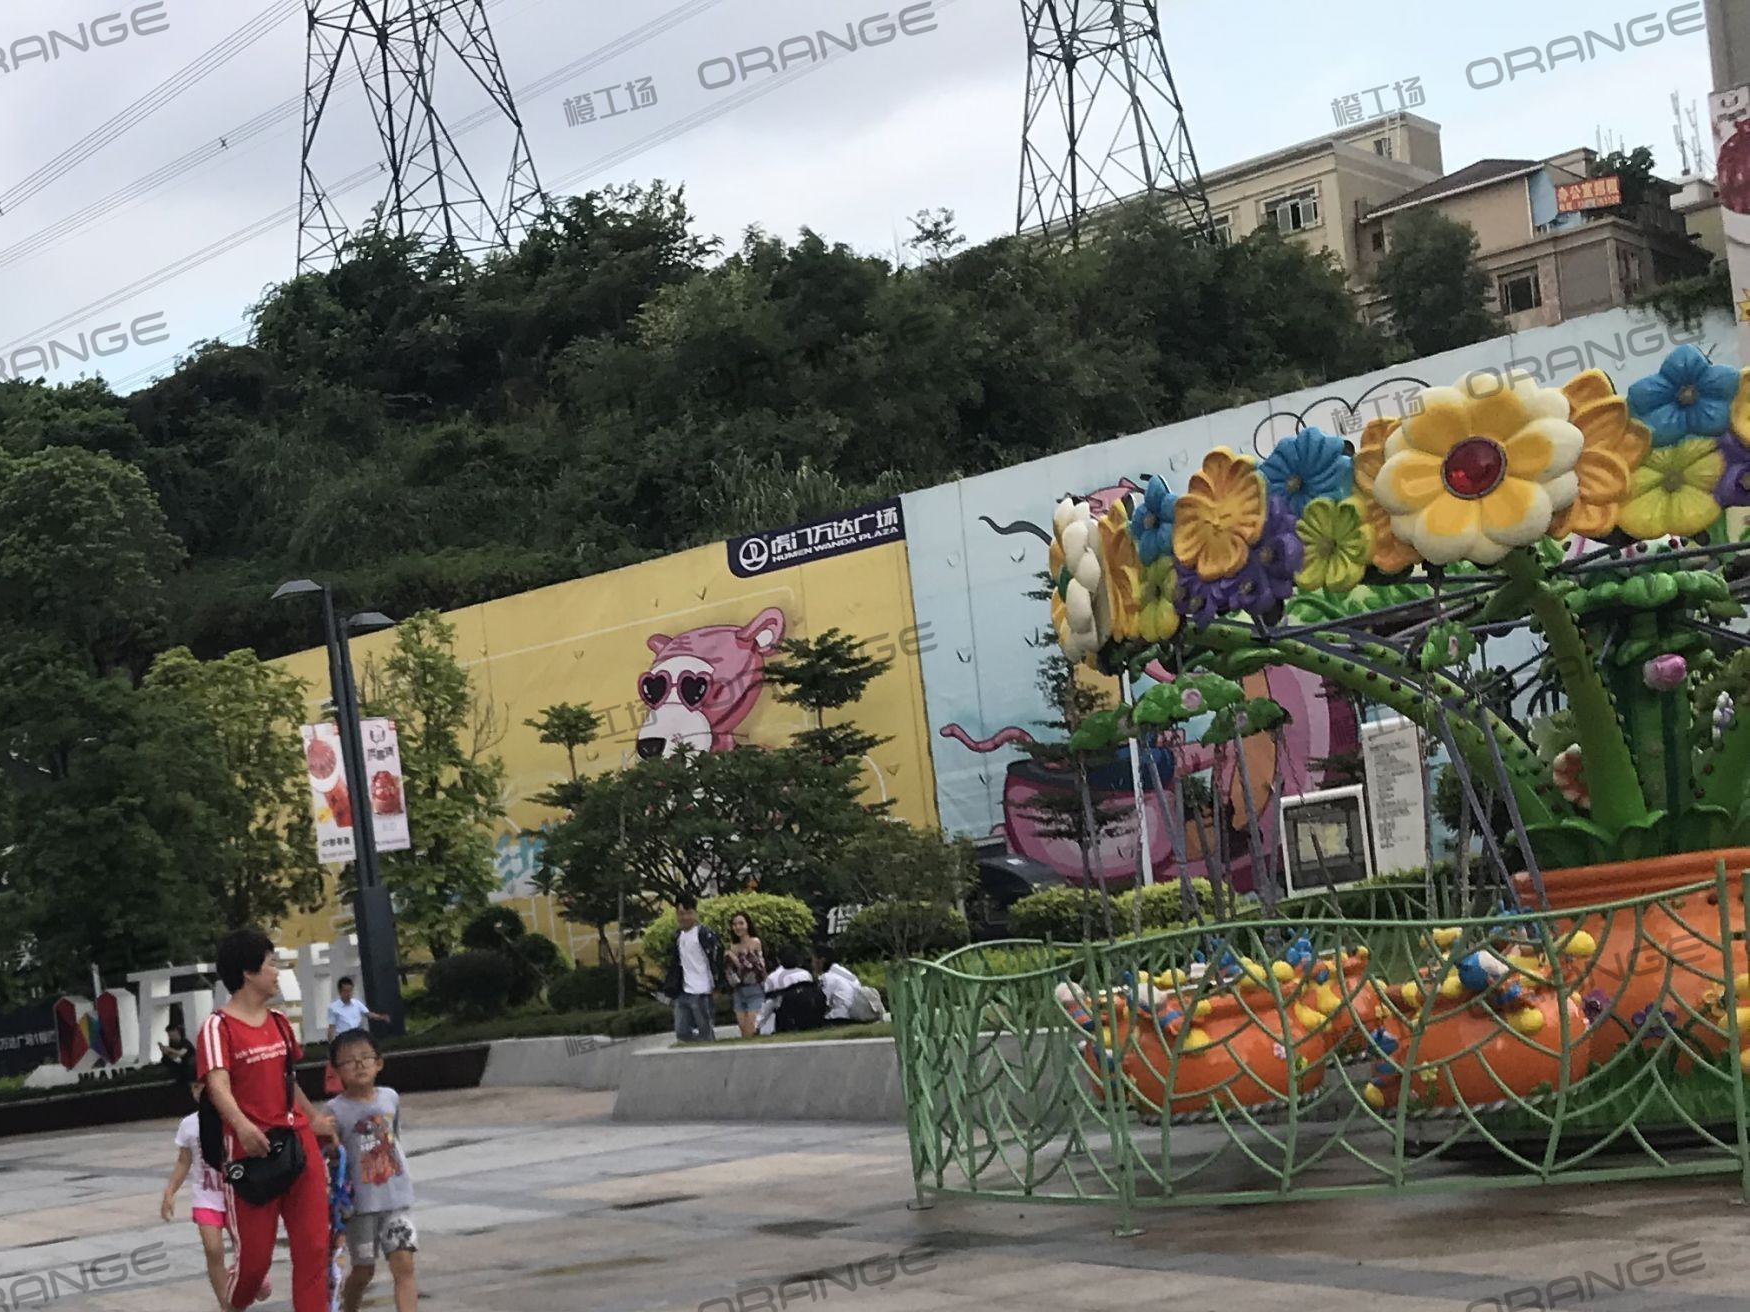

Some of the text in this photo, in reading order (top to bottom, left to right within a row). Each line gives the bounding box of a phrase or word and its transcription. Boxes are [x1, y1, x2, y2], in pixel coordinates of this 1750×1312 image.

[771, 507, 898, 554] 虎门万达广场
[813, 537, 856, 552] WANDA
[858, 526, 898, 541] PLAZA
